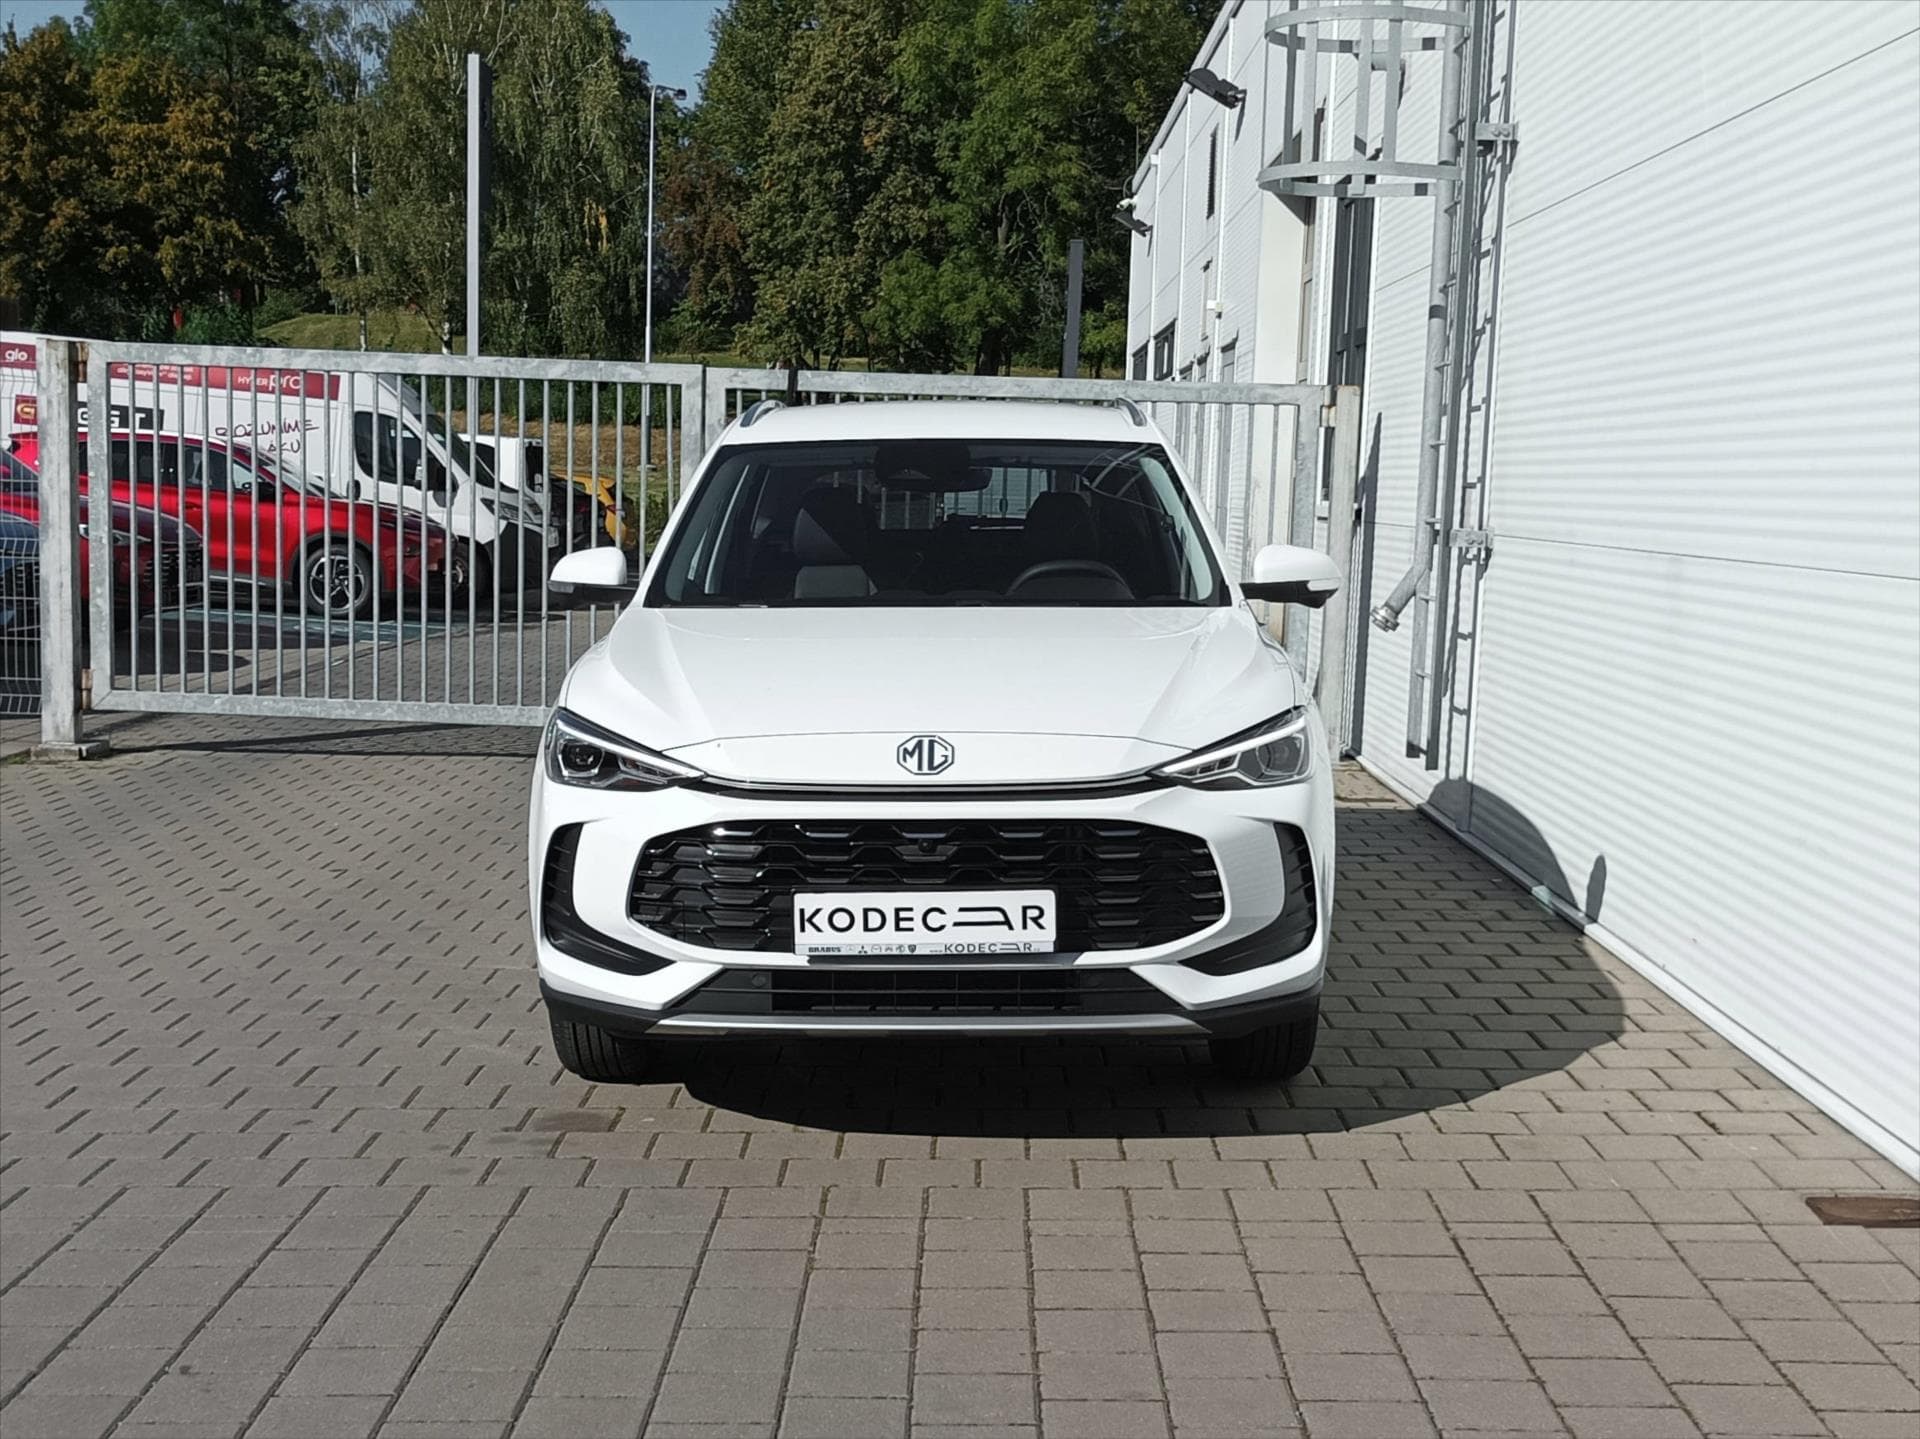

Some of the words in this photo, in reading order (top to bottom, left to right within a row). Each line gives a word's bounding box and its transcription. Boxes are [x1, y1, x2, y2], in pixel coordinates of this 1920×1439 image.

[5, 349, 28, 362] glo
[902, 738, 949, 771] MG
[799, 904, 1046, 933] KODECAR
